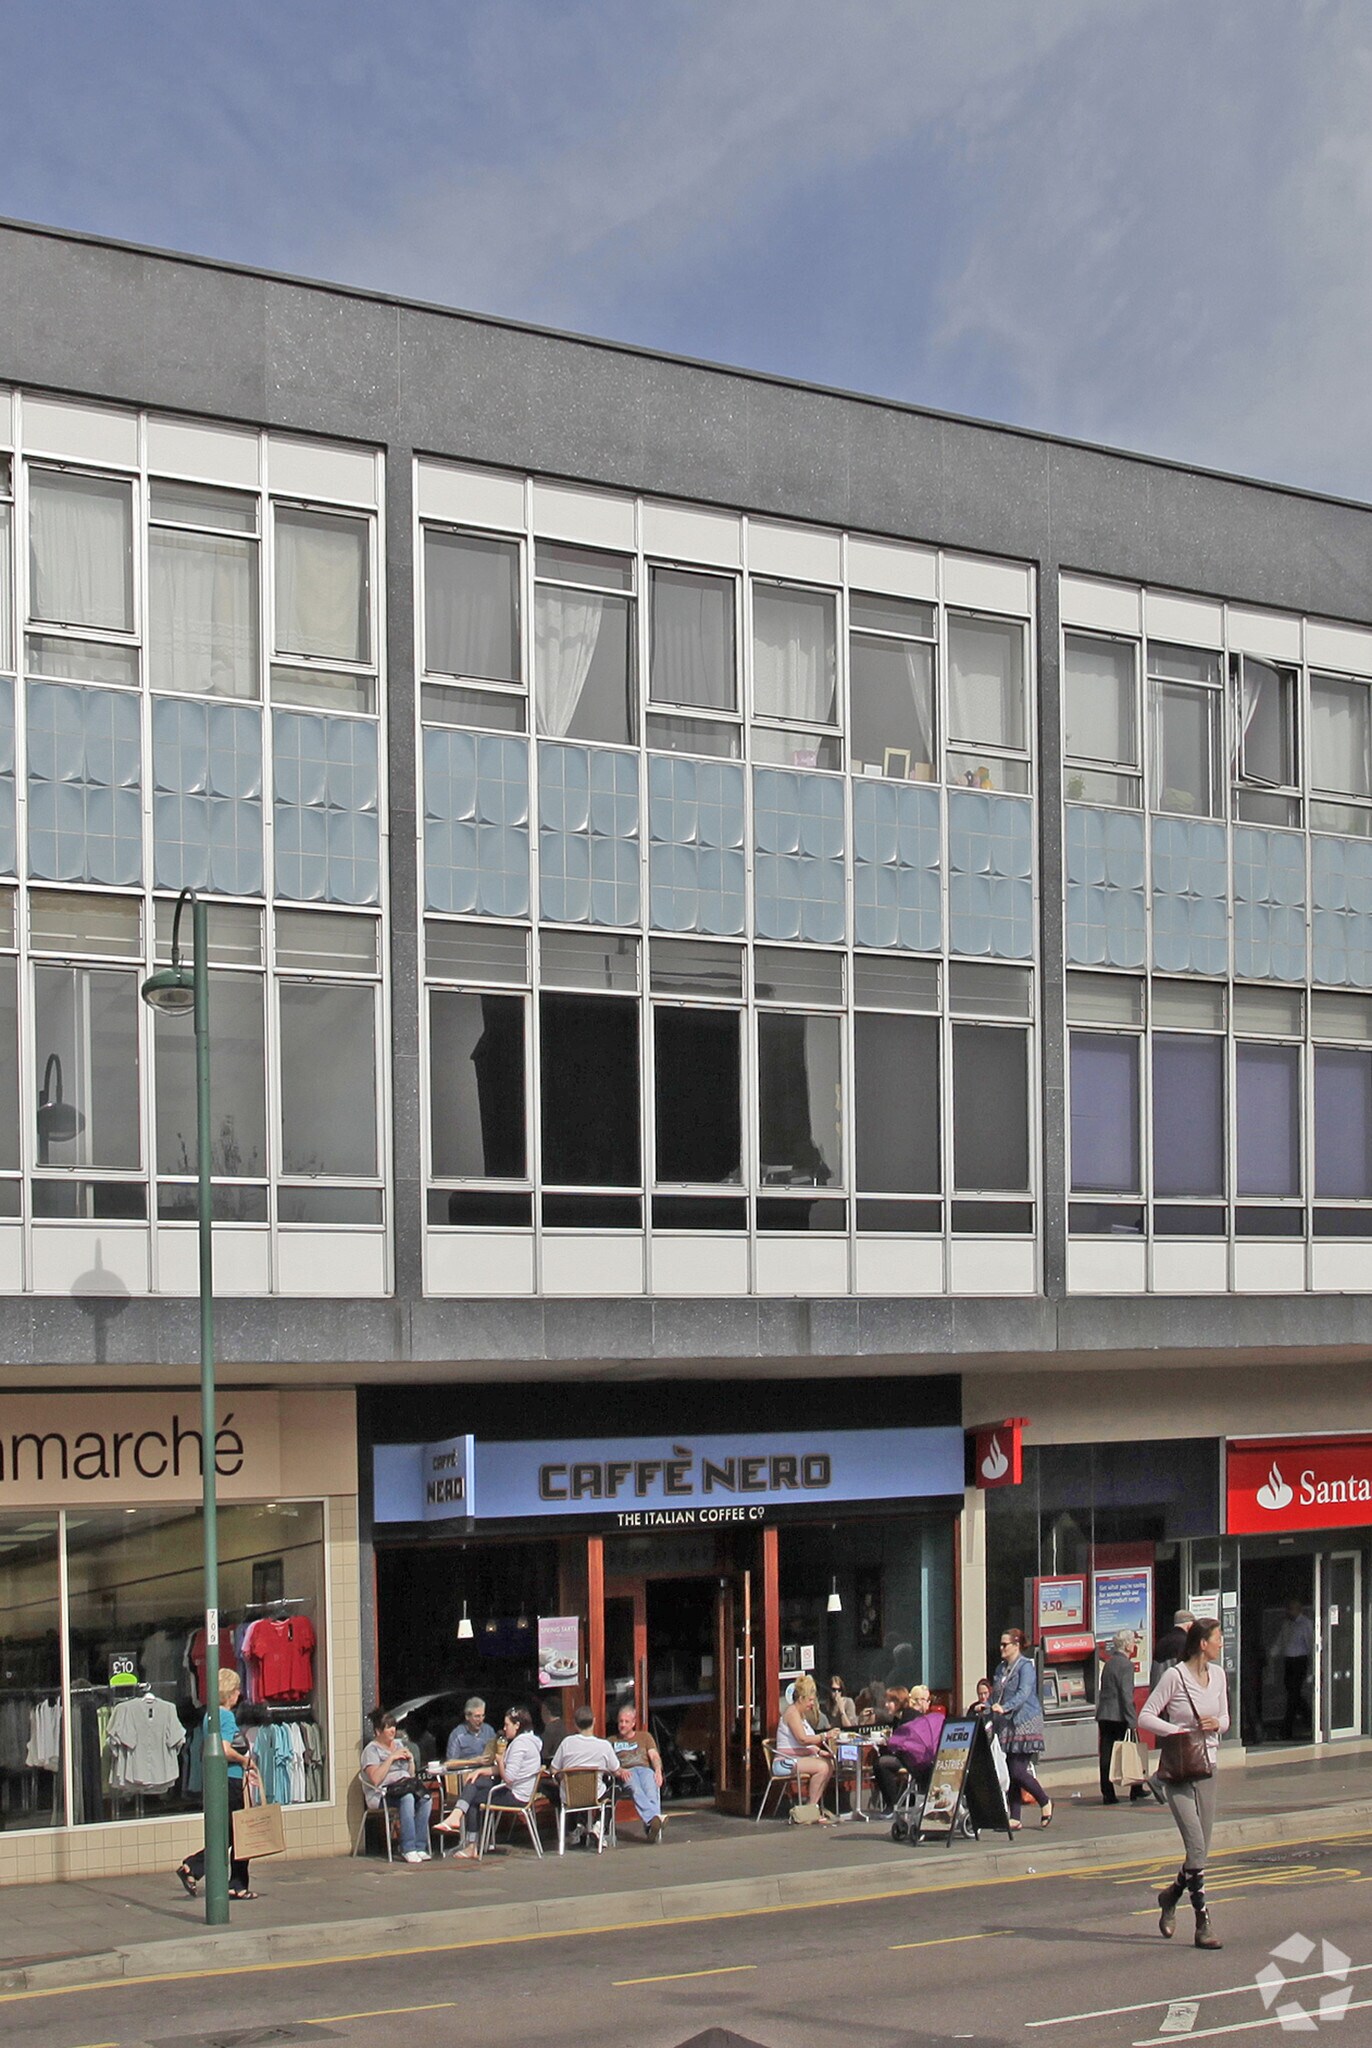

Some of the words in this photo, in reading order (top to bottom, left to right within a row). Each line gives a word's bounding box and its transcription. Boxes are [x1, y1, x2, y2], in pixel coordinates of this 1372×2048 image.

[0, 1413, 244, 1481] marché
[702, 1453, 832, 1494] NERO
[427, 1477, 464, 1504] NERO
[618, 1513, 641, 1526] THE
[645, 1511, 695, 1525] ITALIAN
[699, 1507, 745, 1522] COFFEE
[113, 1661, 134, 1674] £10
[945, 1732, 970, 1743] NERO
[936, 1759, 965, 1770] PASTRIES
